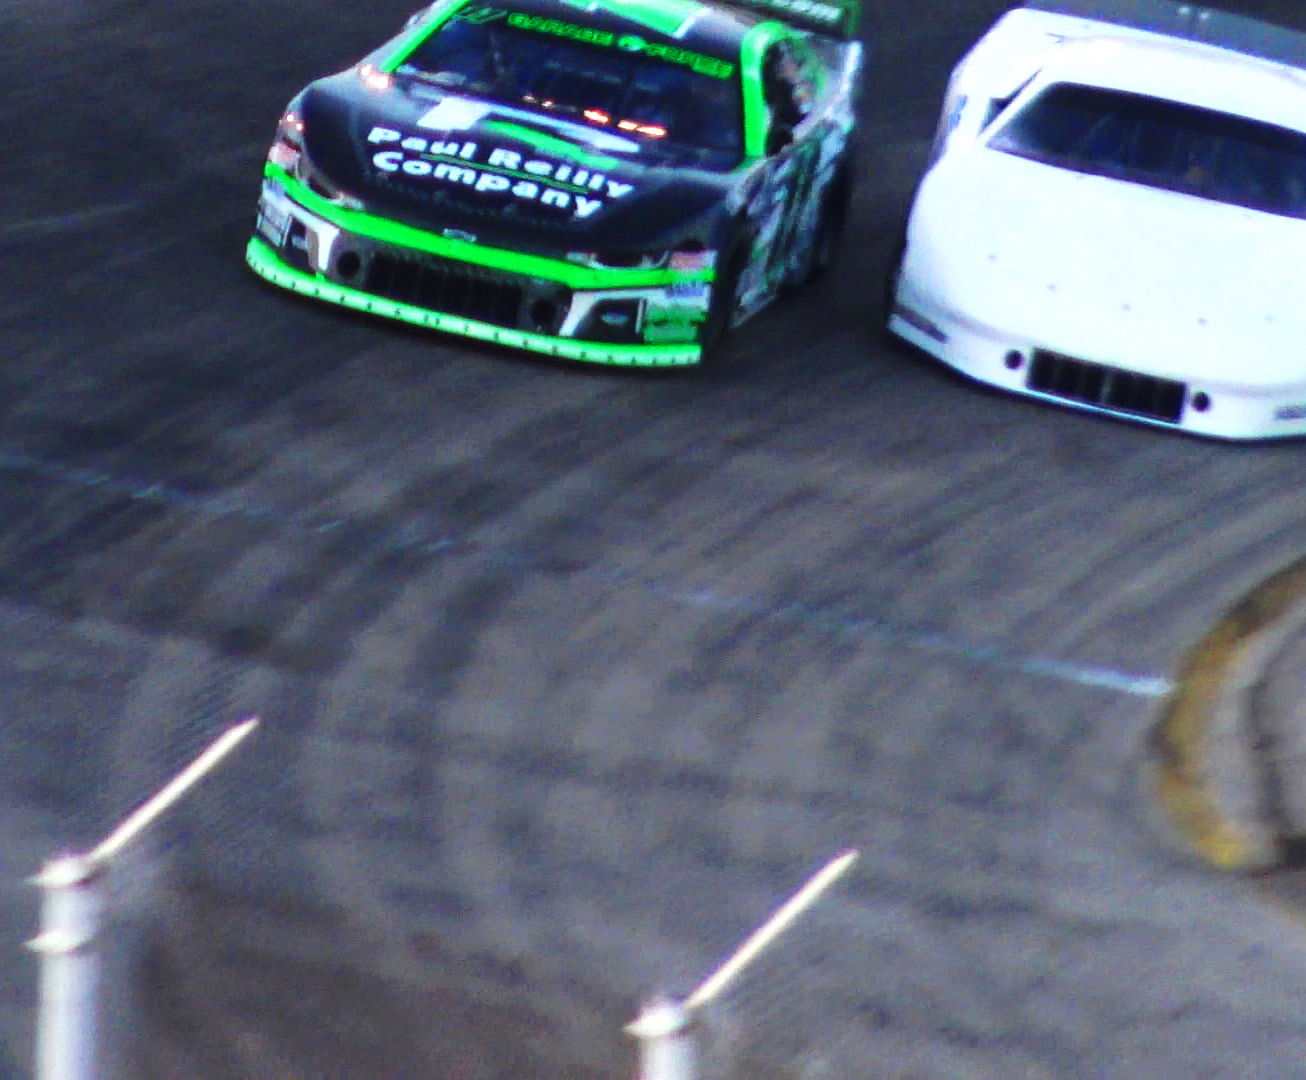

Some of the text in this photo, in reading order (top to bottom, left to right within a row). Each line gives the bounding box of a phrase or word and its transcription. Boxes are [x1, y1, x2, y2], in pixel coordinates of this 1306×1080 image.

[367, 126, 634, 199] Paul Reilly
[372, 150, 604, 219] Company
